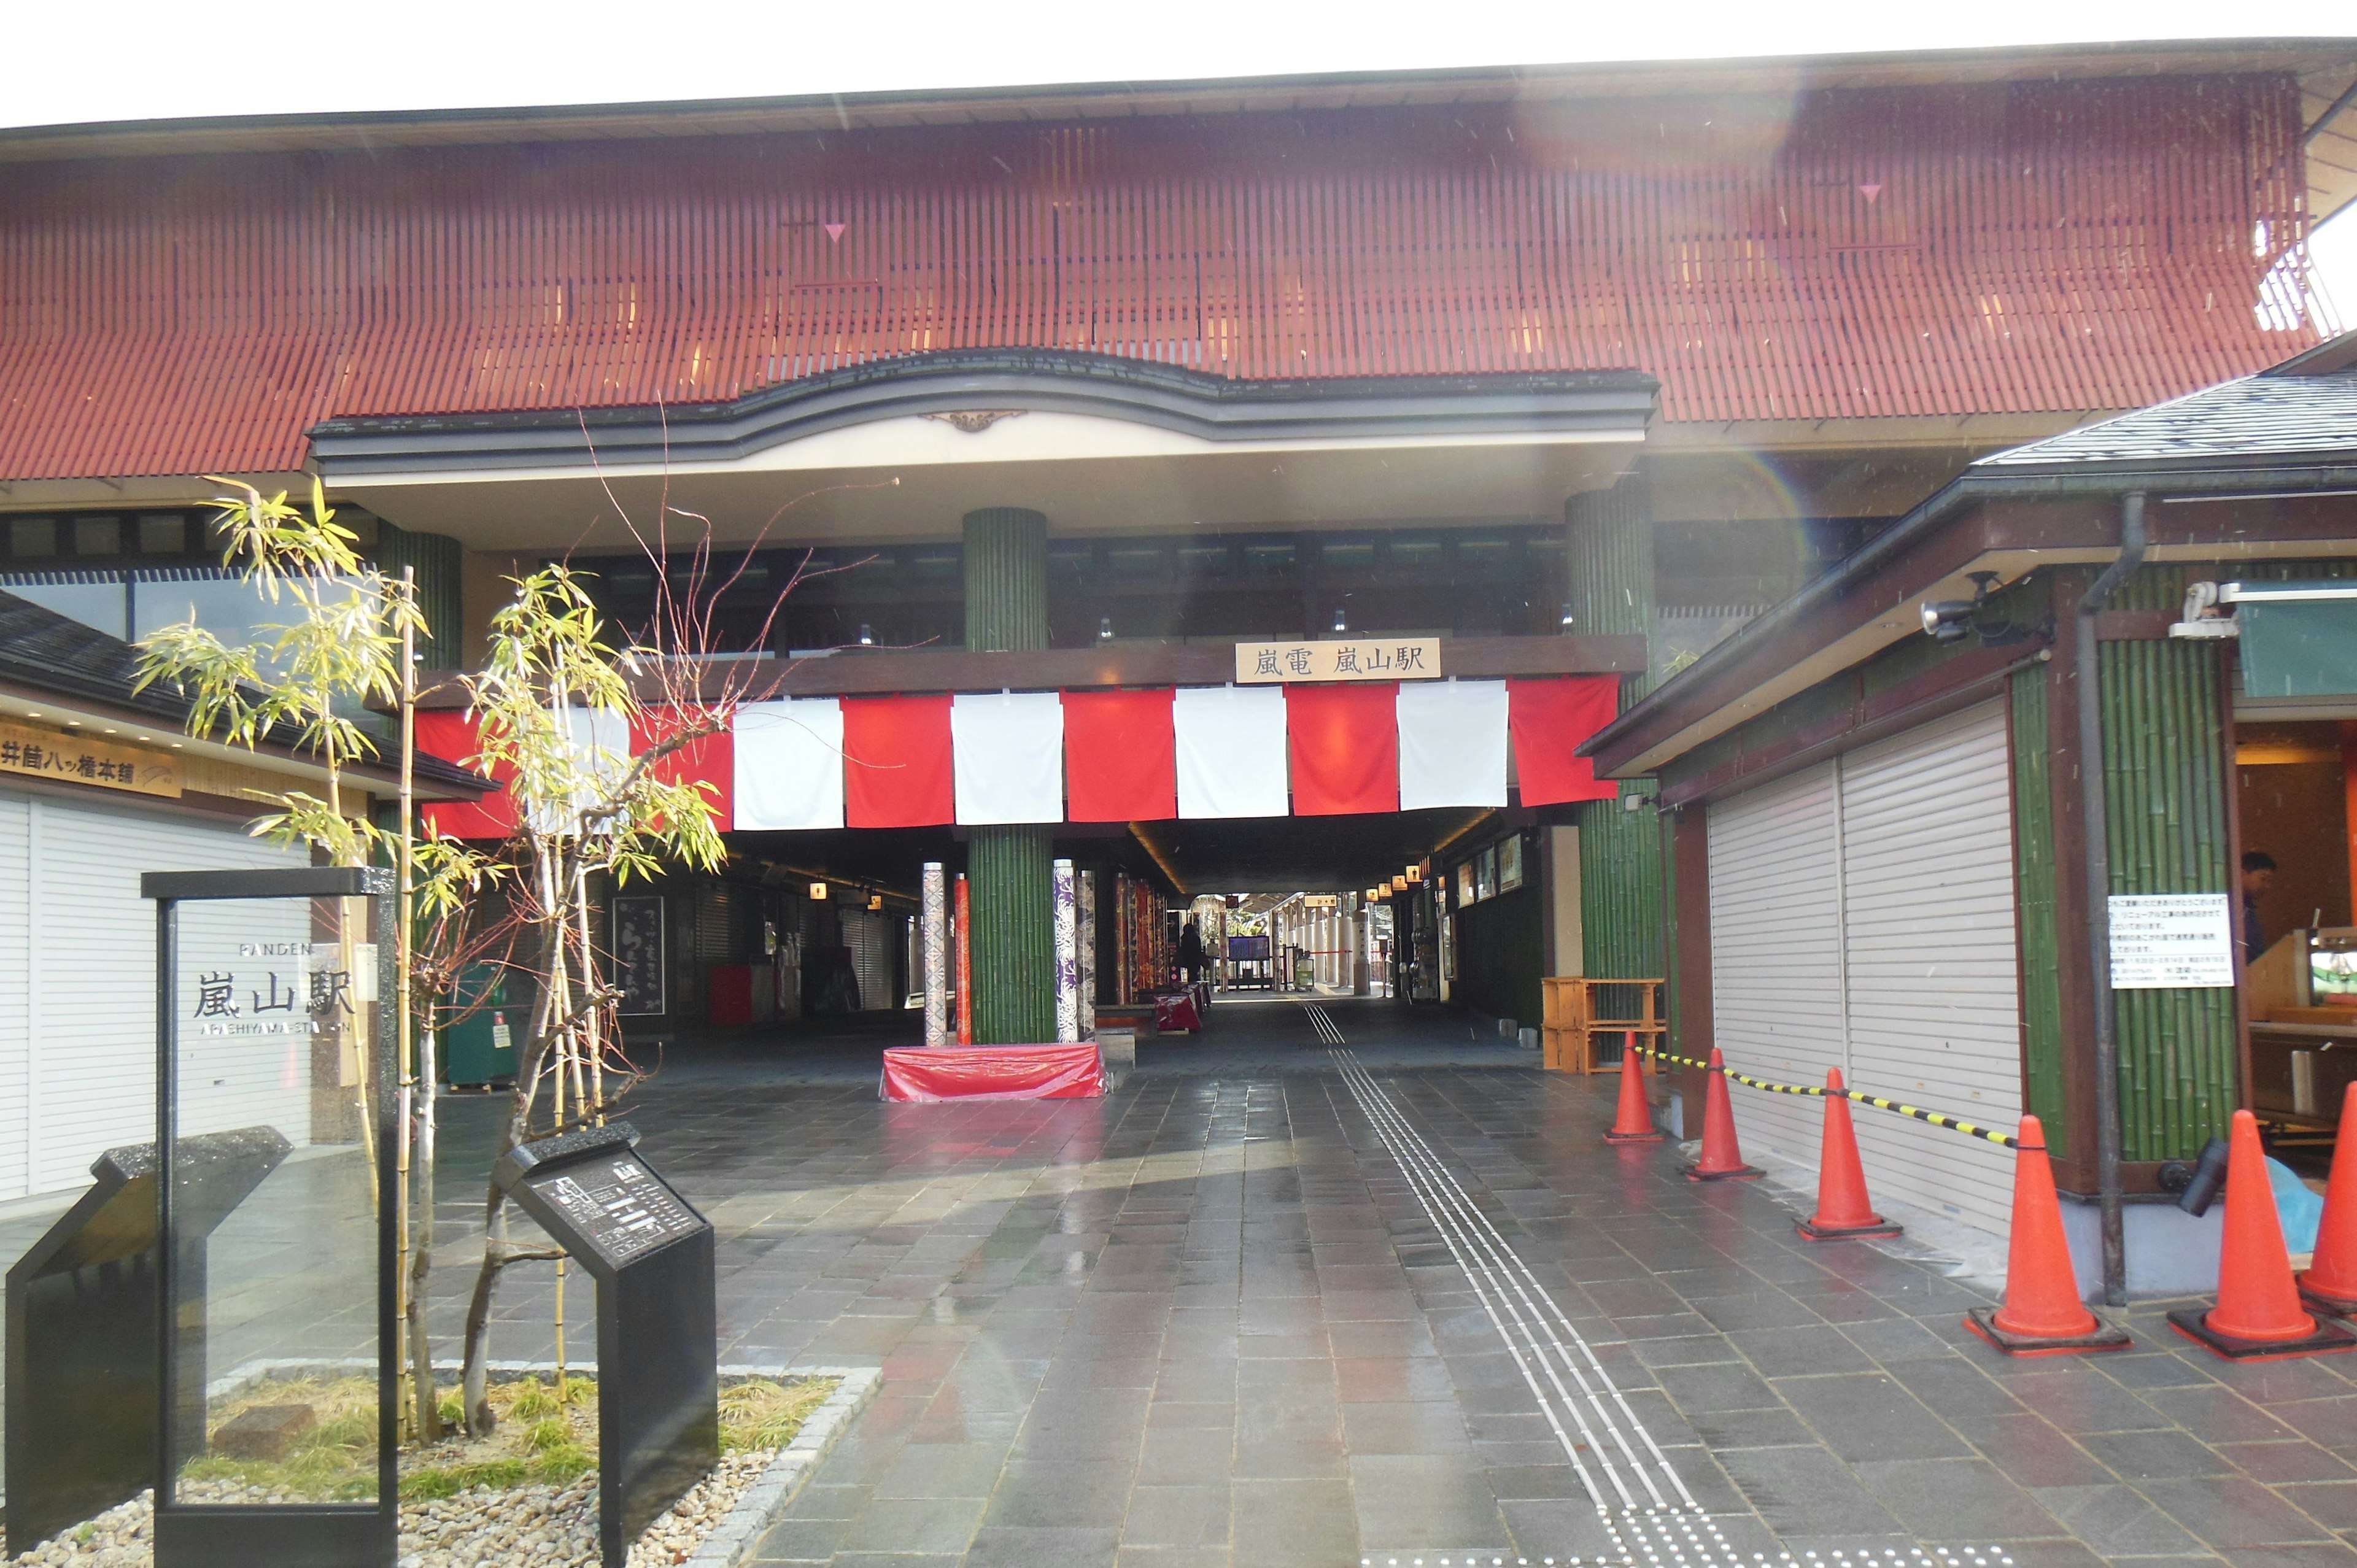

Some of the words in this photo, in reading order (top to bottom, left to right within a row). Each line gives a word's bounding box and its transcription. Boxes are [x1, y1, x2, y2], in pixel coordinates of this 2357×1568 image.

[1253, 647, 1312, 676] 嵐電
[1333, 646, 1425, 674] 嵐山駅
[239, 943, 311, 956] RANDEN
[193, 970, 356, 1019] 嵐山駅
